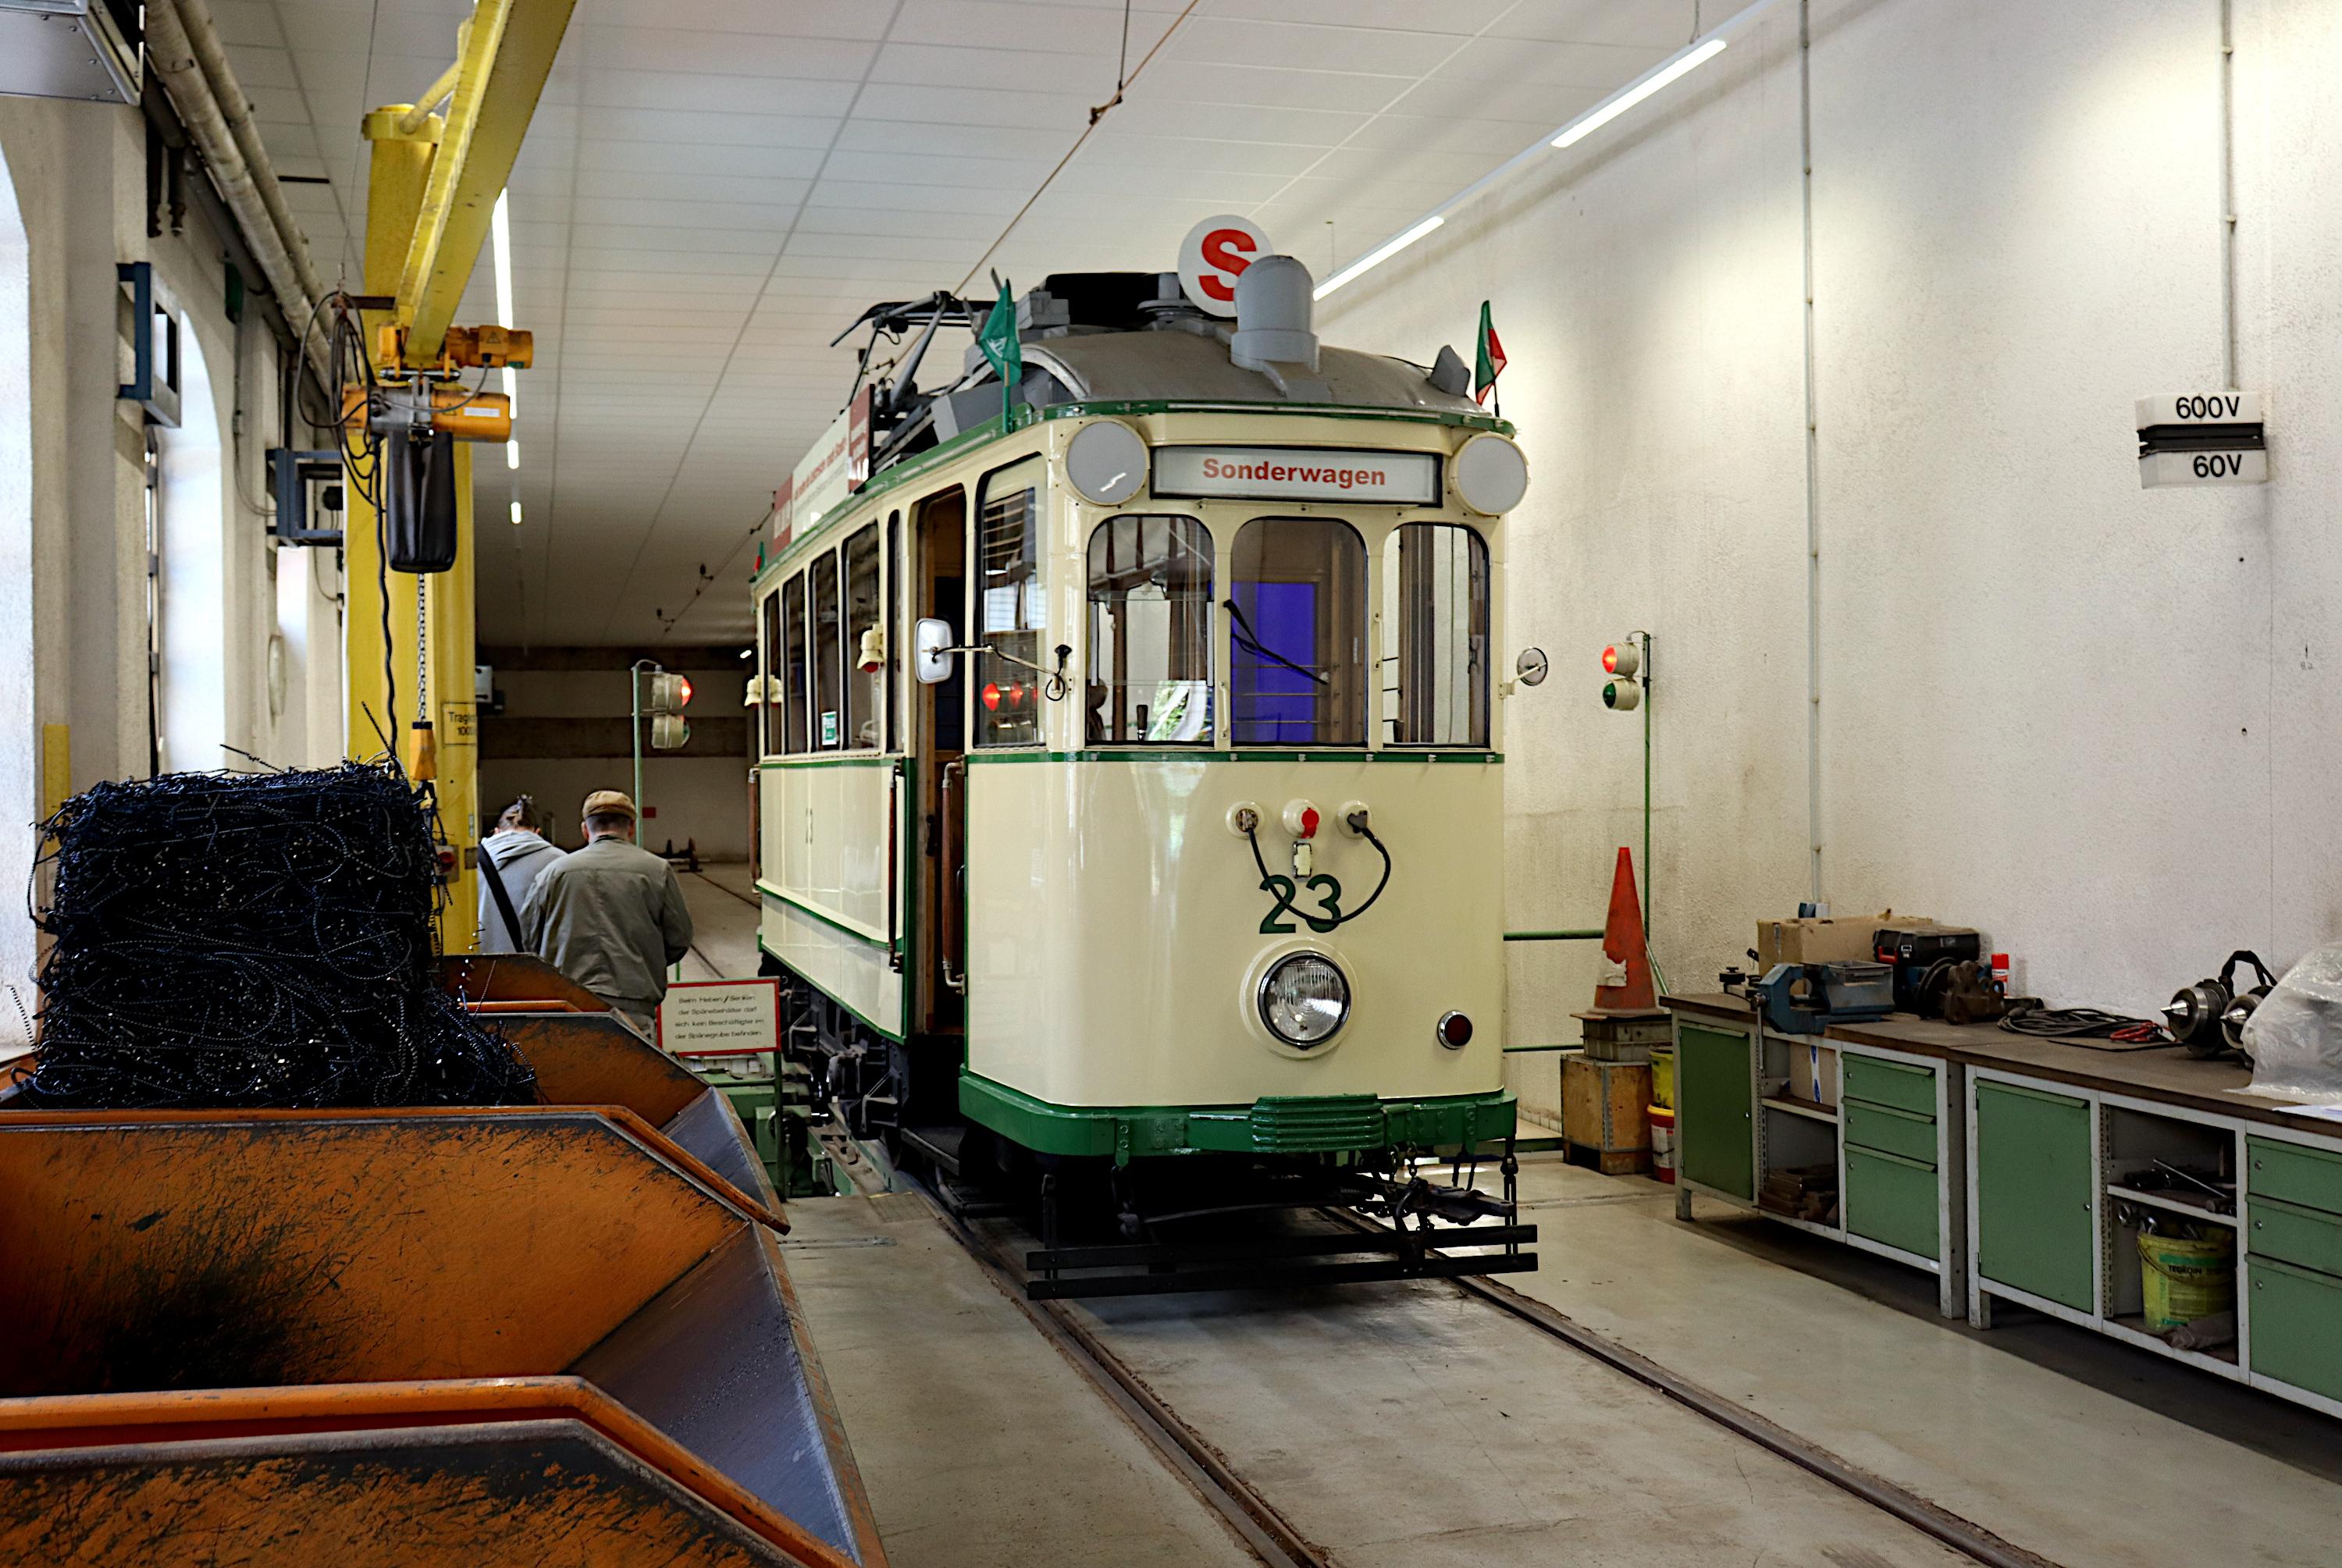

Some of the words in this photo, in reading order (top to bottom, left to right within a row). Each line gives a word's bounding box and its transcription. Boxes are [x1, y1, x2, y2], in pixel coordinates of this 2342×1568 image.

[1198, 229, 1257, 302] S
[2176, 396, 2240, 419] 600V
[1203, 458, 1386, 489] Sonderwagen
[2193, 454, 2242, 478] 60V
[1258, 873, 1342, 934] 23
